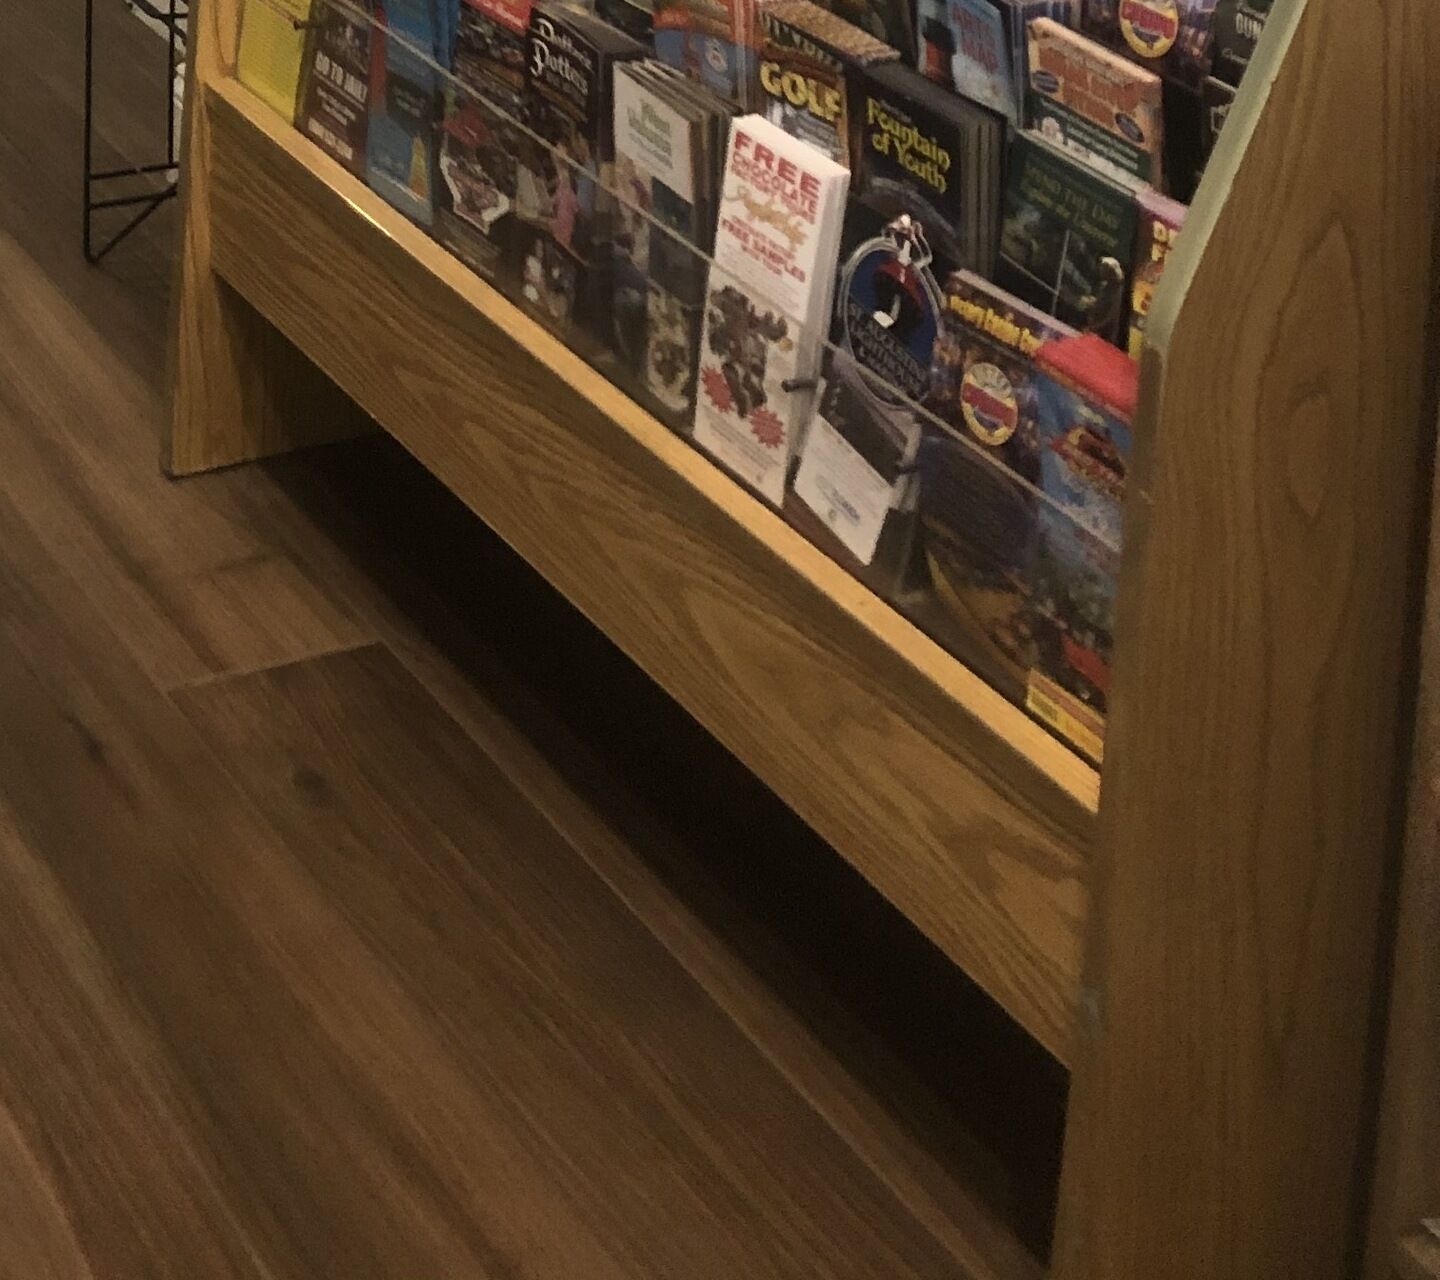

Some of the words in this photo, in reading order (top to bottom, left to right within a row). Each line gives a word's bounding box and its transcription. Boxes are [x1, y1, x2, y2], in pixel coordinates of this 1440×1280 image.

[760, 61, 841, 124] GOLF
[734, 130, 822, 192] FREE
[866, 96, 951, 172] Fountain
[731, 150, 820, 216] CHOCOLATE
[892, 138, 947, 194] Youth
